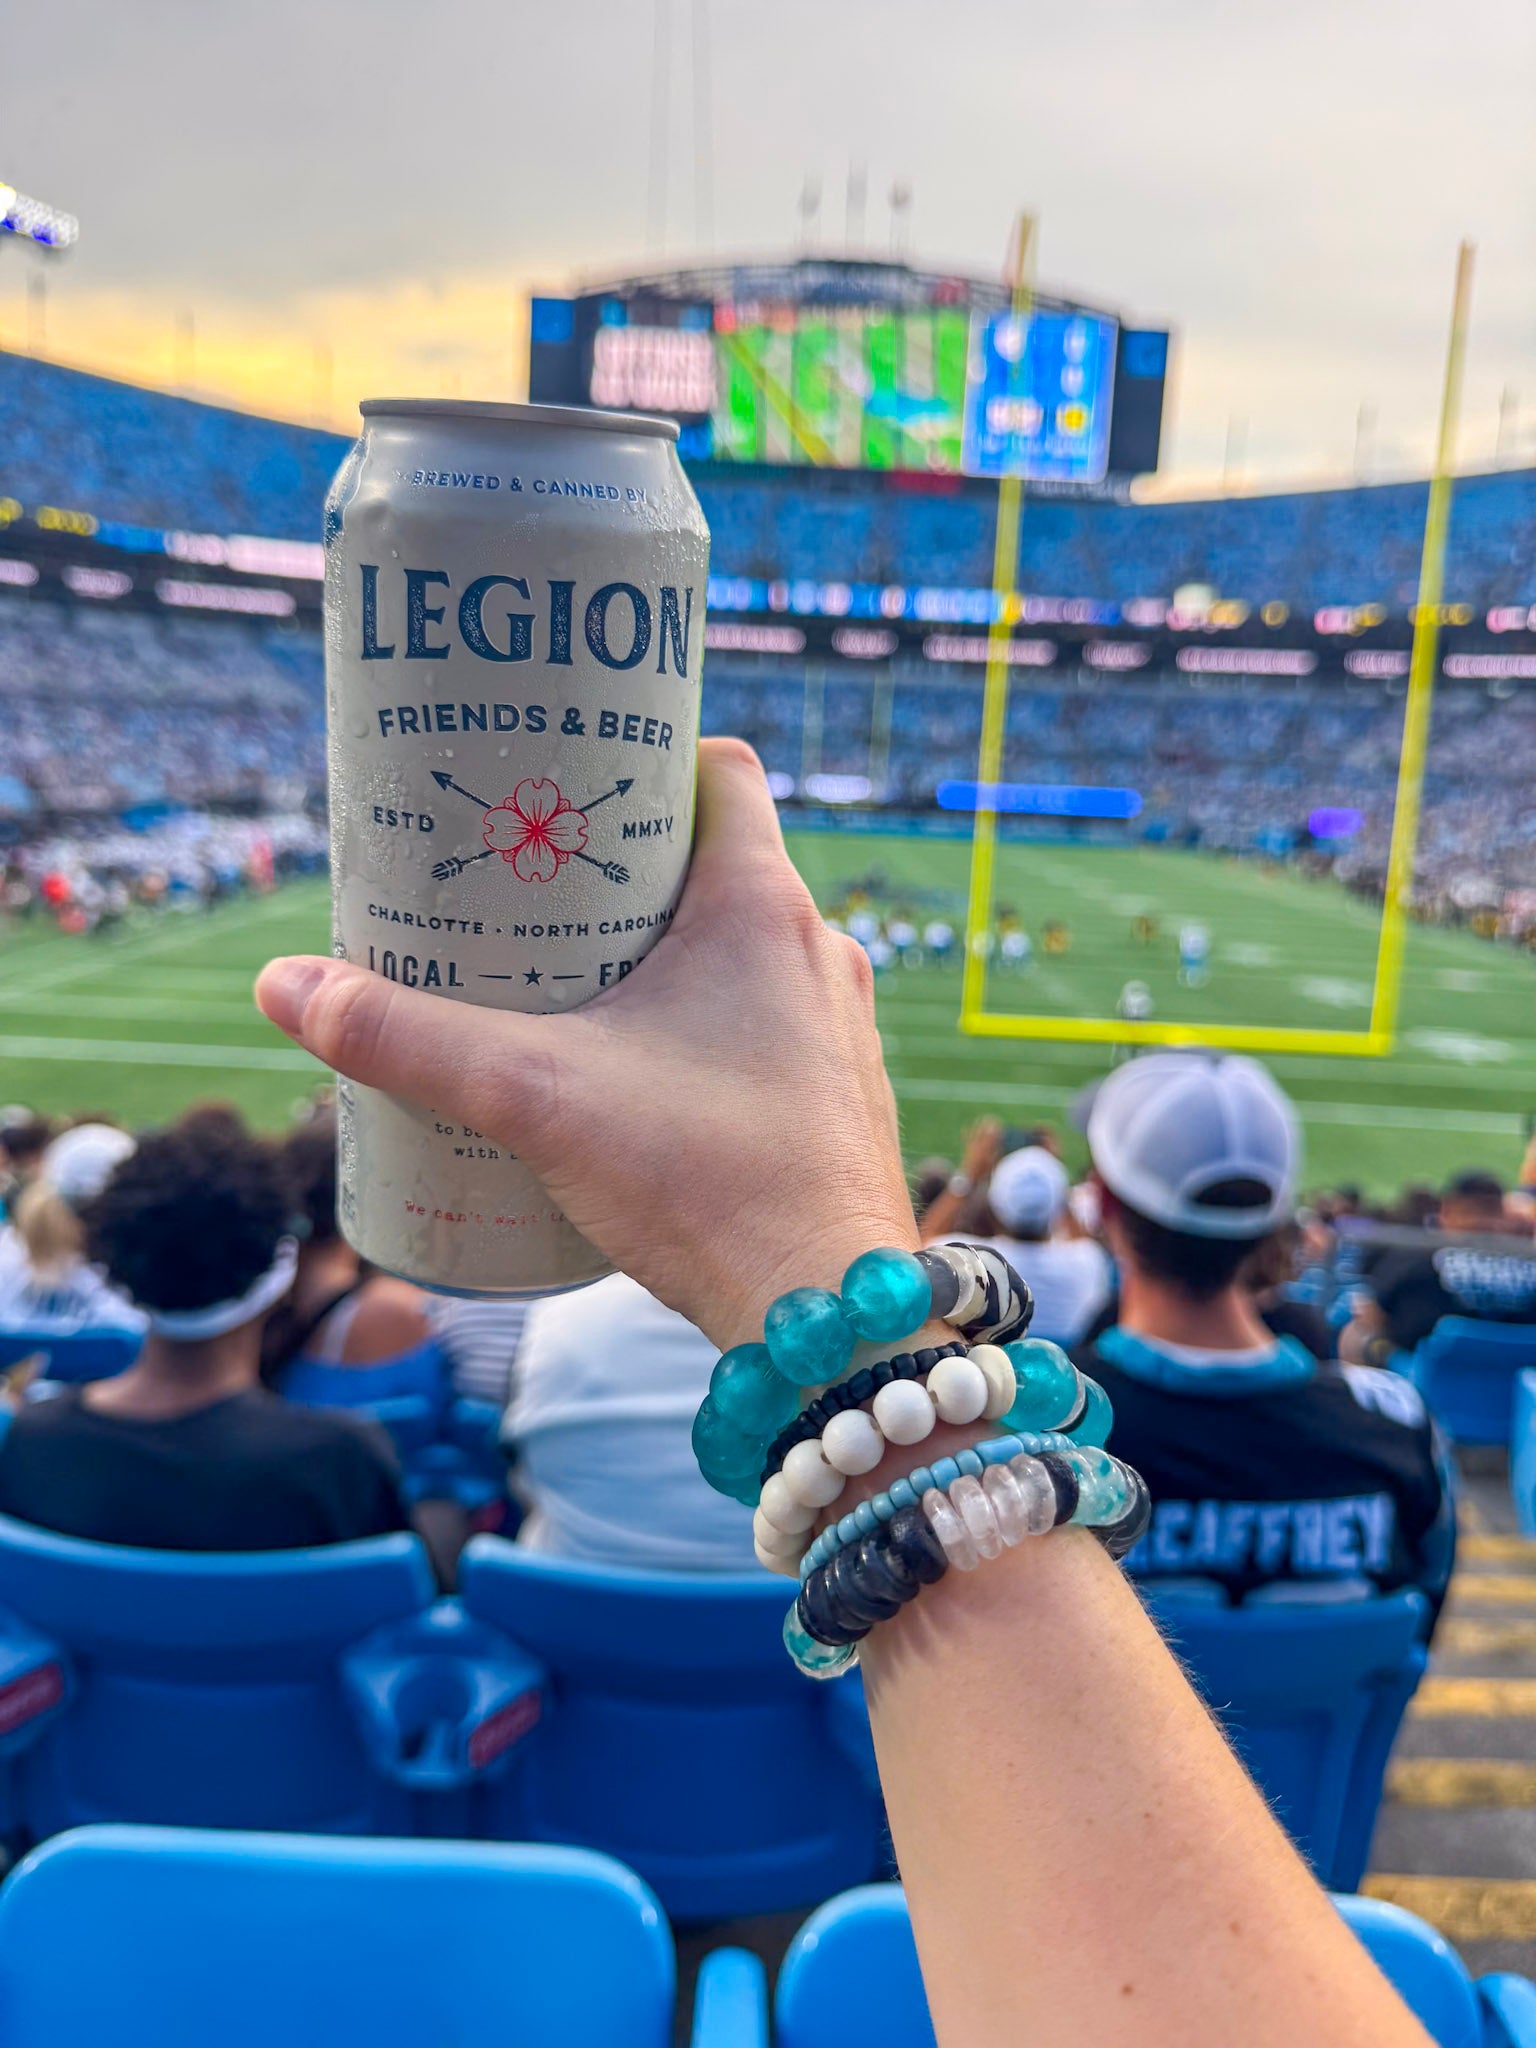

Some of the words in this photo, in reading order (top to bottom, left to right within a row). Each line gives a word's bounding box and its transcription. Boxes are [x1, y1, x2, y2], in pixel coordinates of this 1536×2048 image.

[412, 471, 500, 490] BREWED
[511, 476, 523, 492] &
[533, 480, 619, 500] CANNED
[626, 487, 646, 503] BY
[360, 564, 693, 678] LEGION
[378, 703, 547, 738] FRIENDS
[560, 707, 586, 737] &
[598, 711, 673, 751] BEER
[373, 806, 433, 832] ESTD
[622, 815, 673, 840] MMXV
[368, 904, 484, 935] CHARLOTTE
[514, 923, 589, 937] NORTH
[599, 907, 674, 935] CAROLINA
[369, 945, 465, 988] LOCAL
[599, 956, 645, 986] FR
[434, 1121, 454, 1136] to
[454, 1146, 500, 1160] with
[405, 1200, 426, 1216] We
[434, 1207, 484, 1224] can't
[494, 1213, 539, 1226] wait
